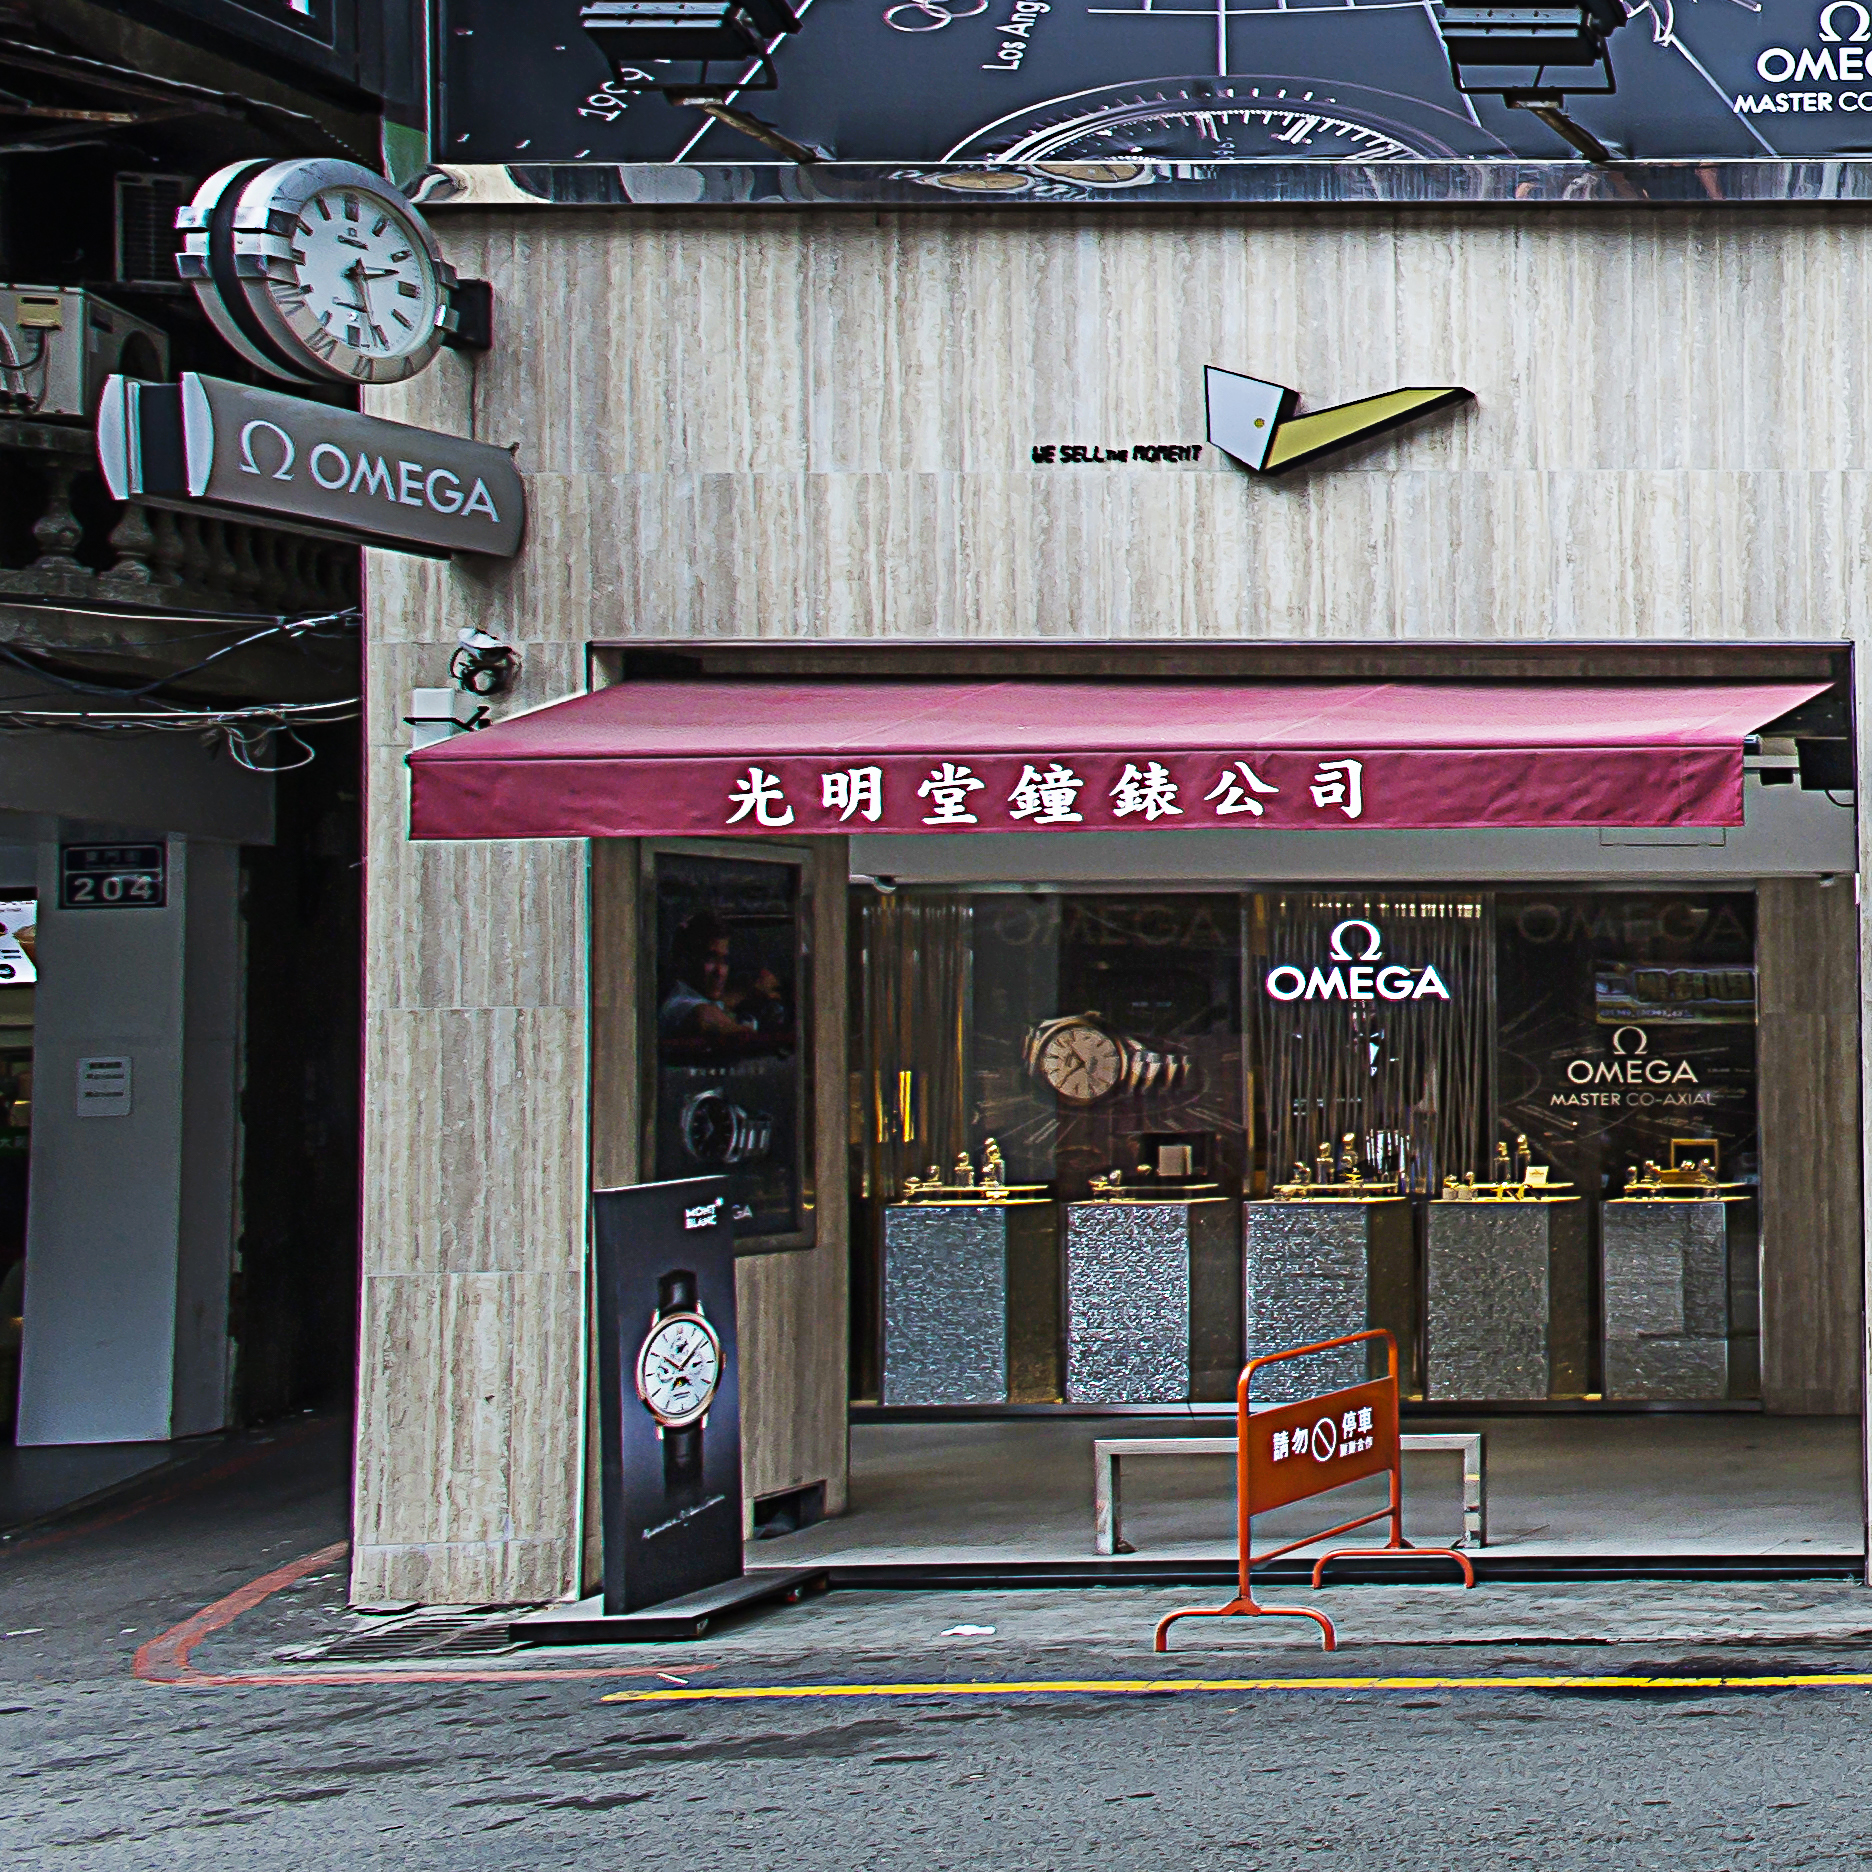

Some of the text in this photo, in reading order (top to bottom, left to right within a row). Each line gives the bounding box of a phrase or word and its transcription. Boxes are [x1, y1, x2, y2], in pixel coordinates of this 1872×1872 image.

[980, 33, 1026, 72] Los
[1732, 92, 1834, 115] MASTER
[1060, 445, 1105, 464] SELL
[1132, 444, 1203, 463] MOMENT
[309, 442, 501, 524] OMEGA
[725, 759, 1366, 828] 光明堂鐘錶公司
[72, 877, 154, 902] 204
[1266, 964, 1450, 1002] OMEGA
[1566, 1059, 1700, 1085] OMEGA
[1550, 1092, 1718, 1107] MASTER CO-AXIAL
[1271, 1405, 1374, 1463] 請勿 停車
